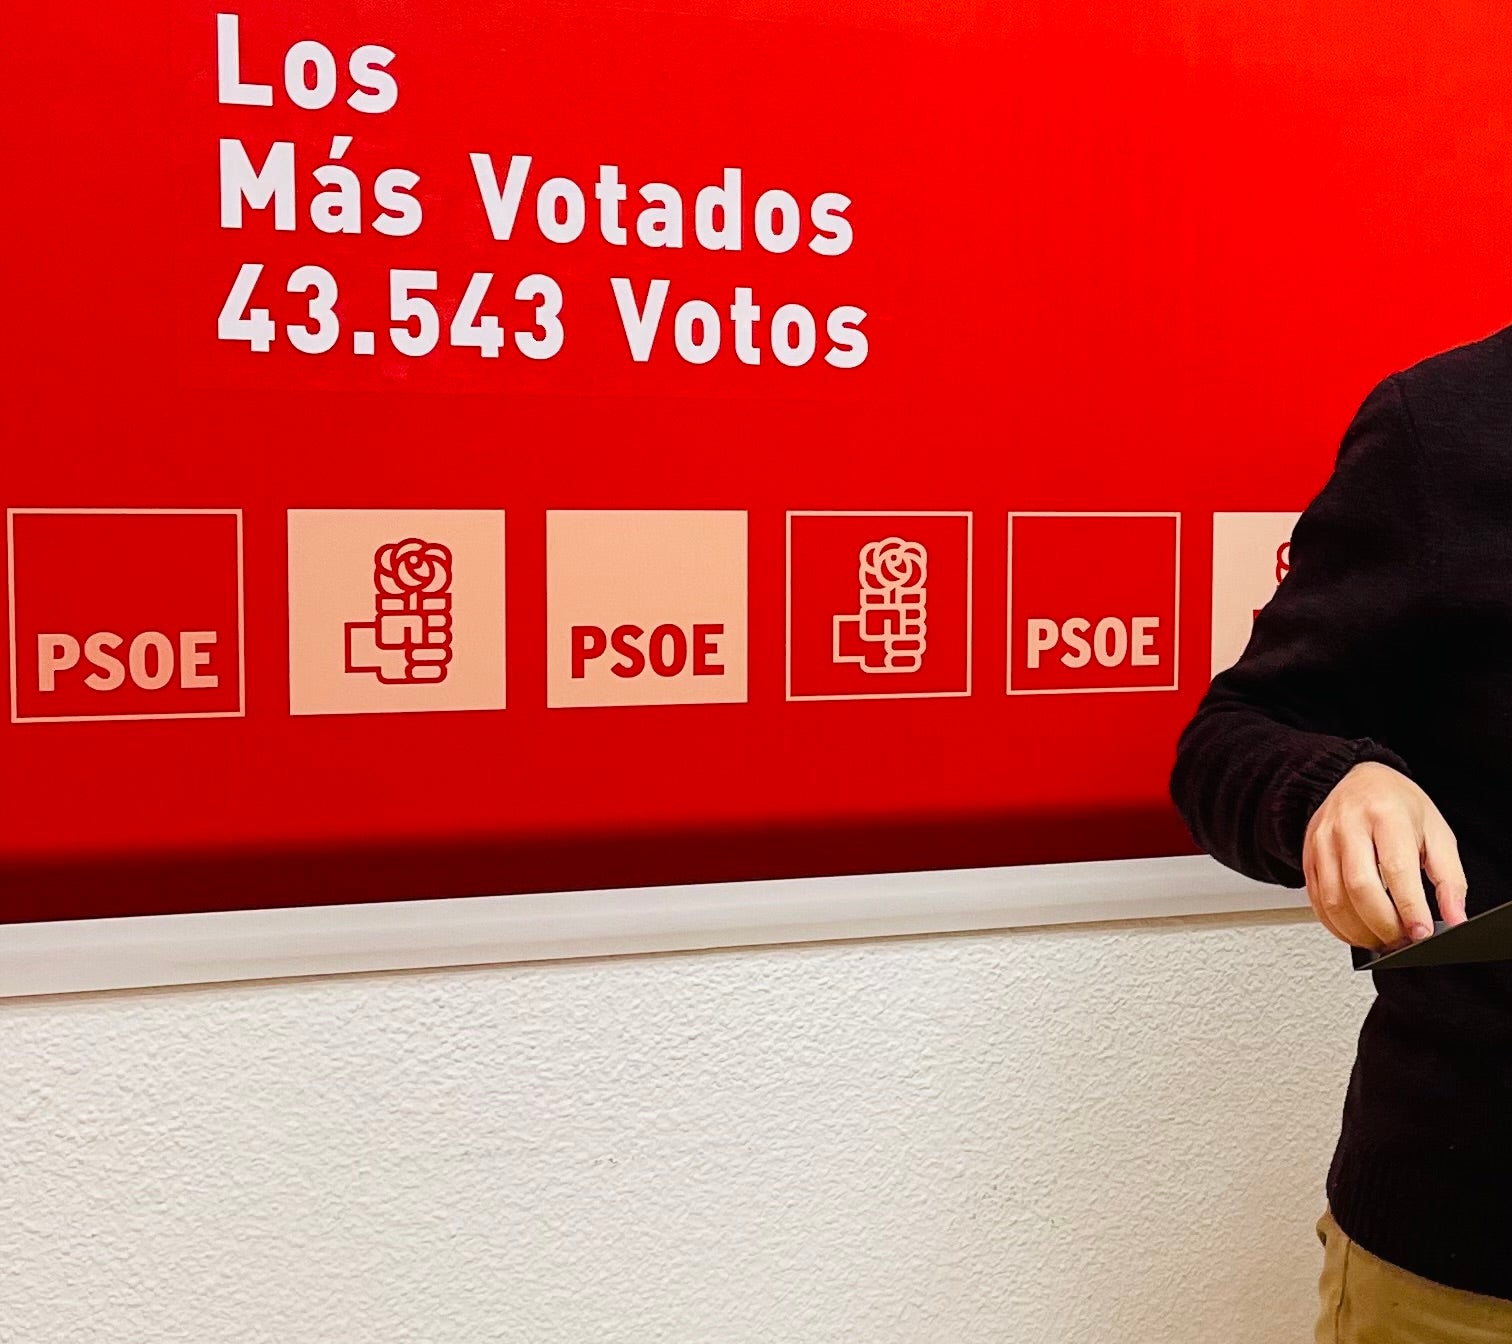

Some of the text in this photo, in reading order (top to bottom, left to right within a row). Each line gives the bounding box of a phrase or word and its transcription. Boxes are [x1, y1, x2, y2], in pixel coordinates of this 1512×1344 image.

[217, 12, 399, 113] Los
[219, 136, 853, 256] Más Votados
[217, 263, 869, 368] 43.543 Votos
[37, 631, 219, 692] PSOE
[571, 623, 725, 679] PSOE
[1026, 616, 1160, 669] PSOE
